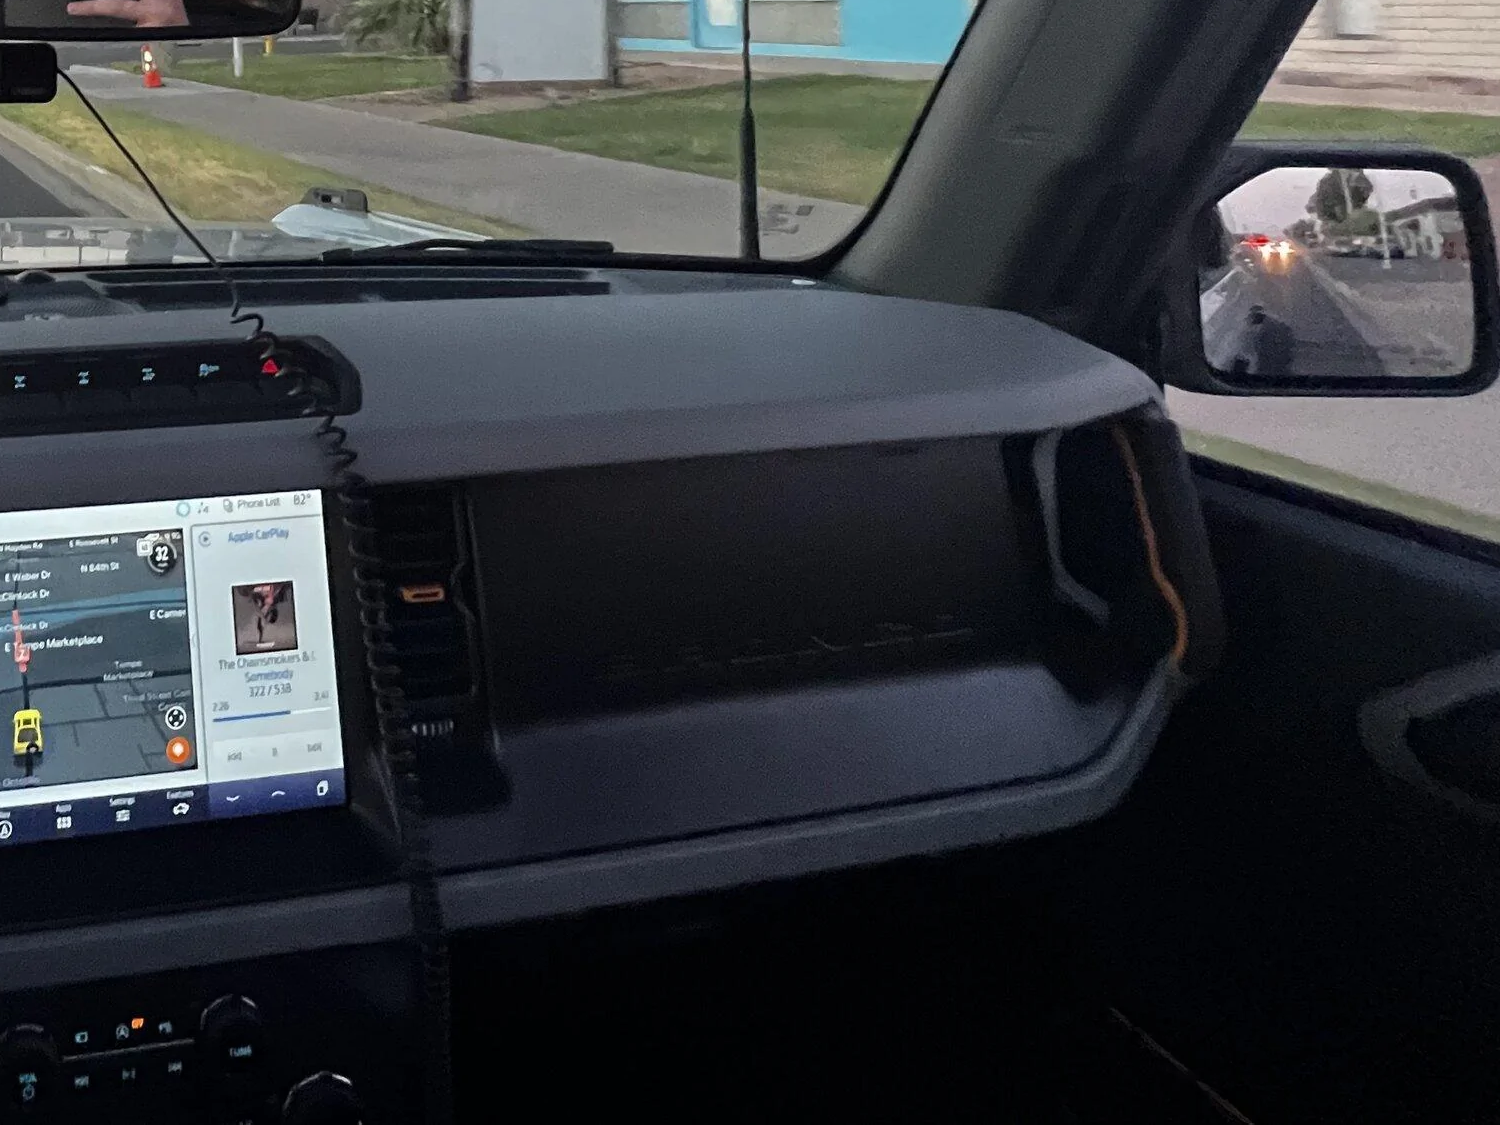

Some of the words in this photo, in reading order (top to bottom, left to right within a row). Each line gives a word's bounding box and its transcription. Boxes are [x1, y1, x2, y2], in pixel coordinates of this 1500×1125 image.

[228, 529, 254, 543] Apple
[255, 527, 290, 540] CarPlay
[155, 546, 169, 561] 32
[41, 570, 51, 580] Dr
[39, 589, 50, 599] Dr
[46, 634, 104, 649] Marketplace
[218, 659, 236, 671] The
[237, 653, 301, 669] Chainsmokers
[244, 668, 294, 683] Somebody
